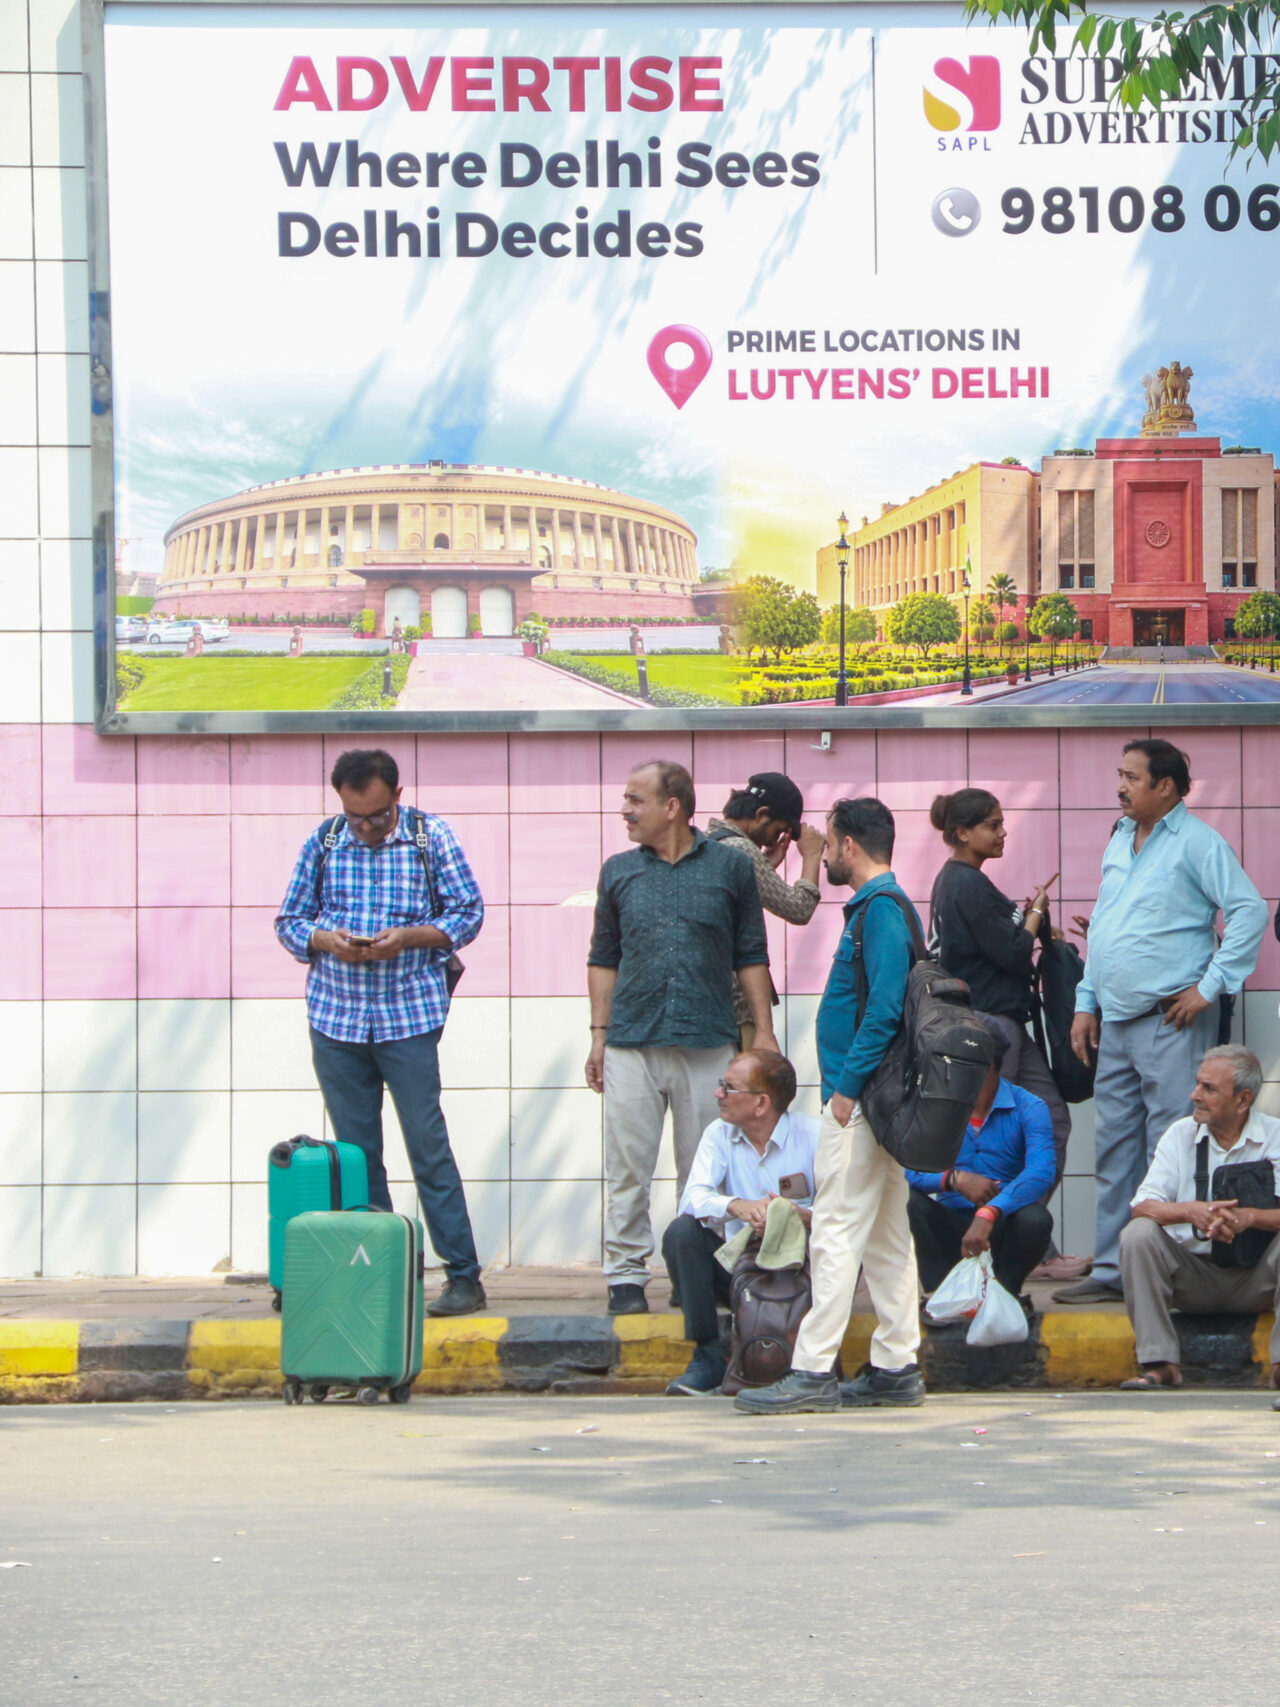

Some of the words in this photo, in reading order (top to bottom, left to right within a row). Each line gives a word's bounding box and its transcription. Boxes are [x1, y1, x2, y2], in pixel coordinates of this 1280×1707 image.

[274, 55, 724, 112] ADVERTISE
[274, 140, 487, 188] Where
[500, 136, 661, 188] Delhi
[675, 142, 820, 188] Sees
[937, 137, 992, 151] SAPL
[278, 206, 440, 258] Delhi
[455, 206, 703, 258] Decides
[1000, 184, 1186, 235] 98108
[728, 330, 816, 352] PRIME
[825, 329, 984, 352] LOCATIONS
[993, 329, 1019, 350] IN
[729, 368, 920, 400] LUTYENS’
[932, 367, 1049, 399] DELHI
